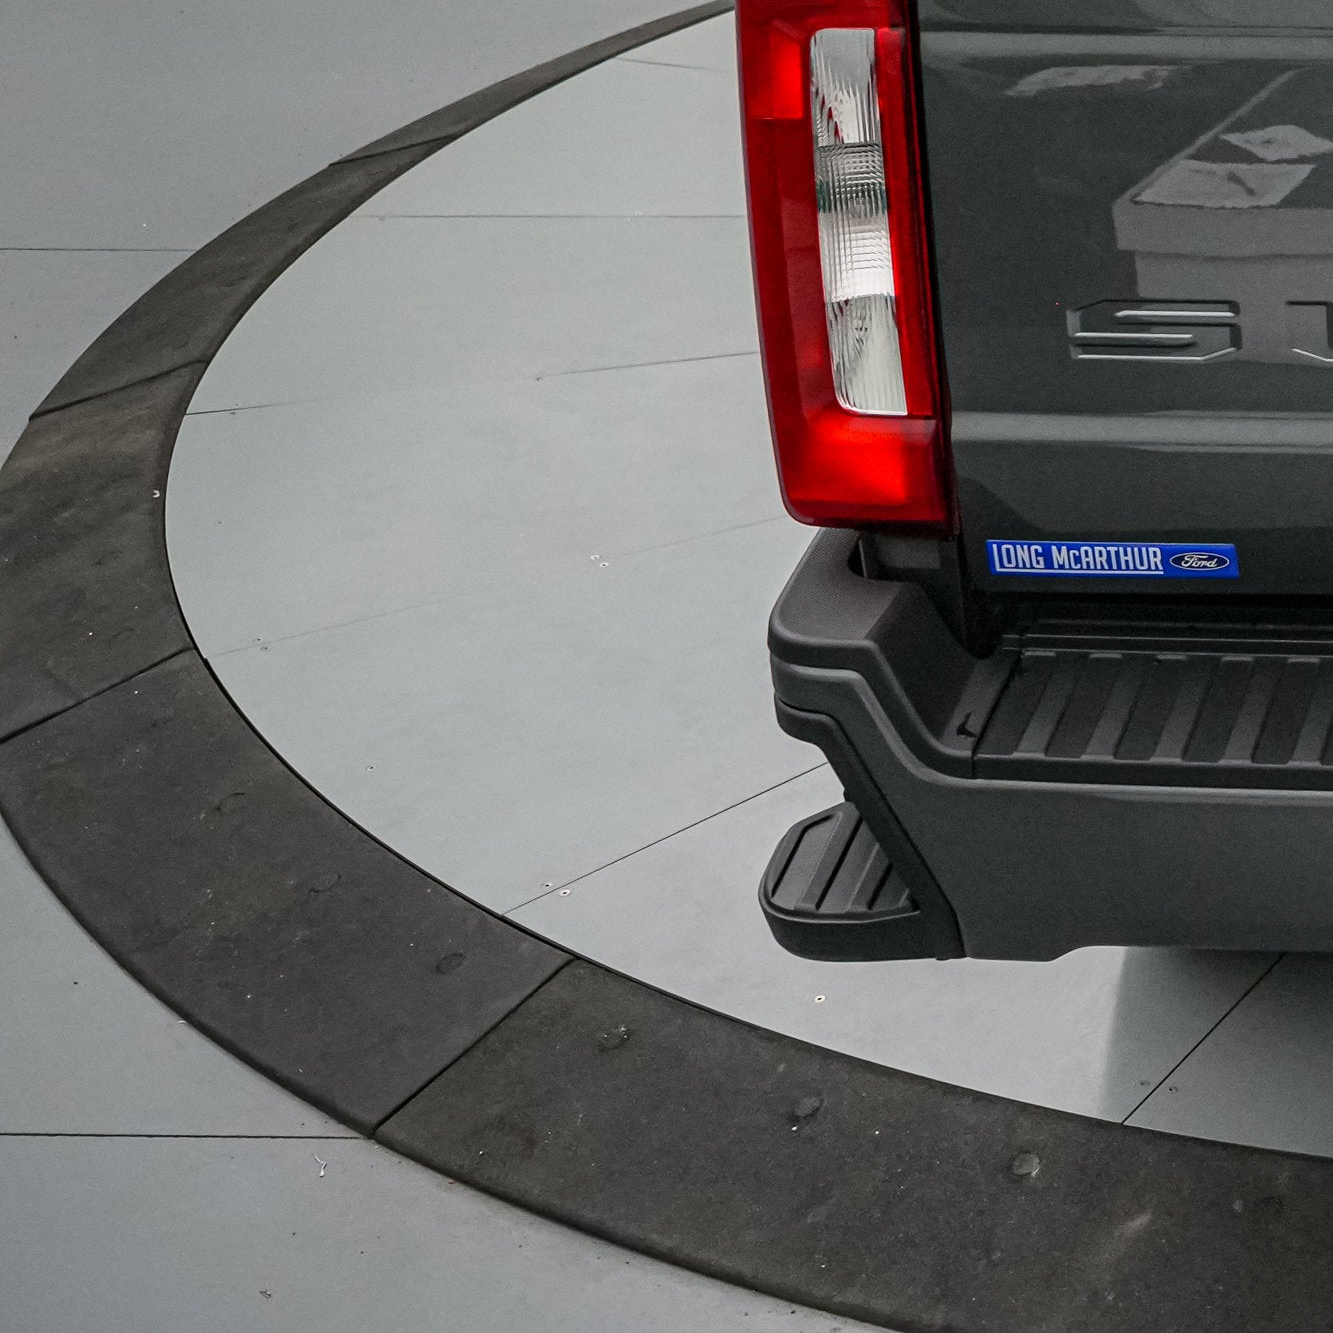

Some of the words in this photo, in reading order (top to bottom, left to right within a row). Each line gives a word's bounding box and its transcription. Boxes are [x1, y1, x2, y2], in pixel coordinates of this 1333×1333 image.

[992, 544, 1044, 572] LONG
[1052, 546, 1164, 571] McARTHUR
[1181, 554, 1218, 568] Ford
